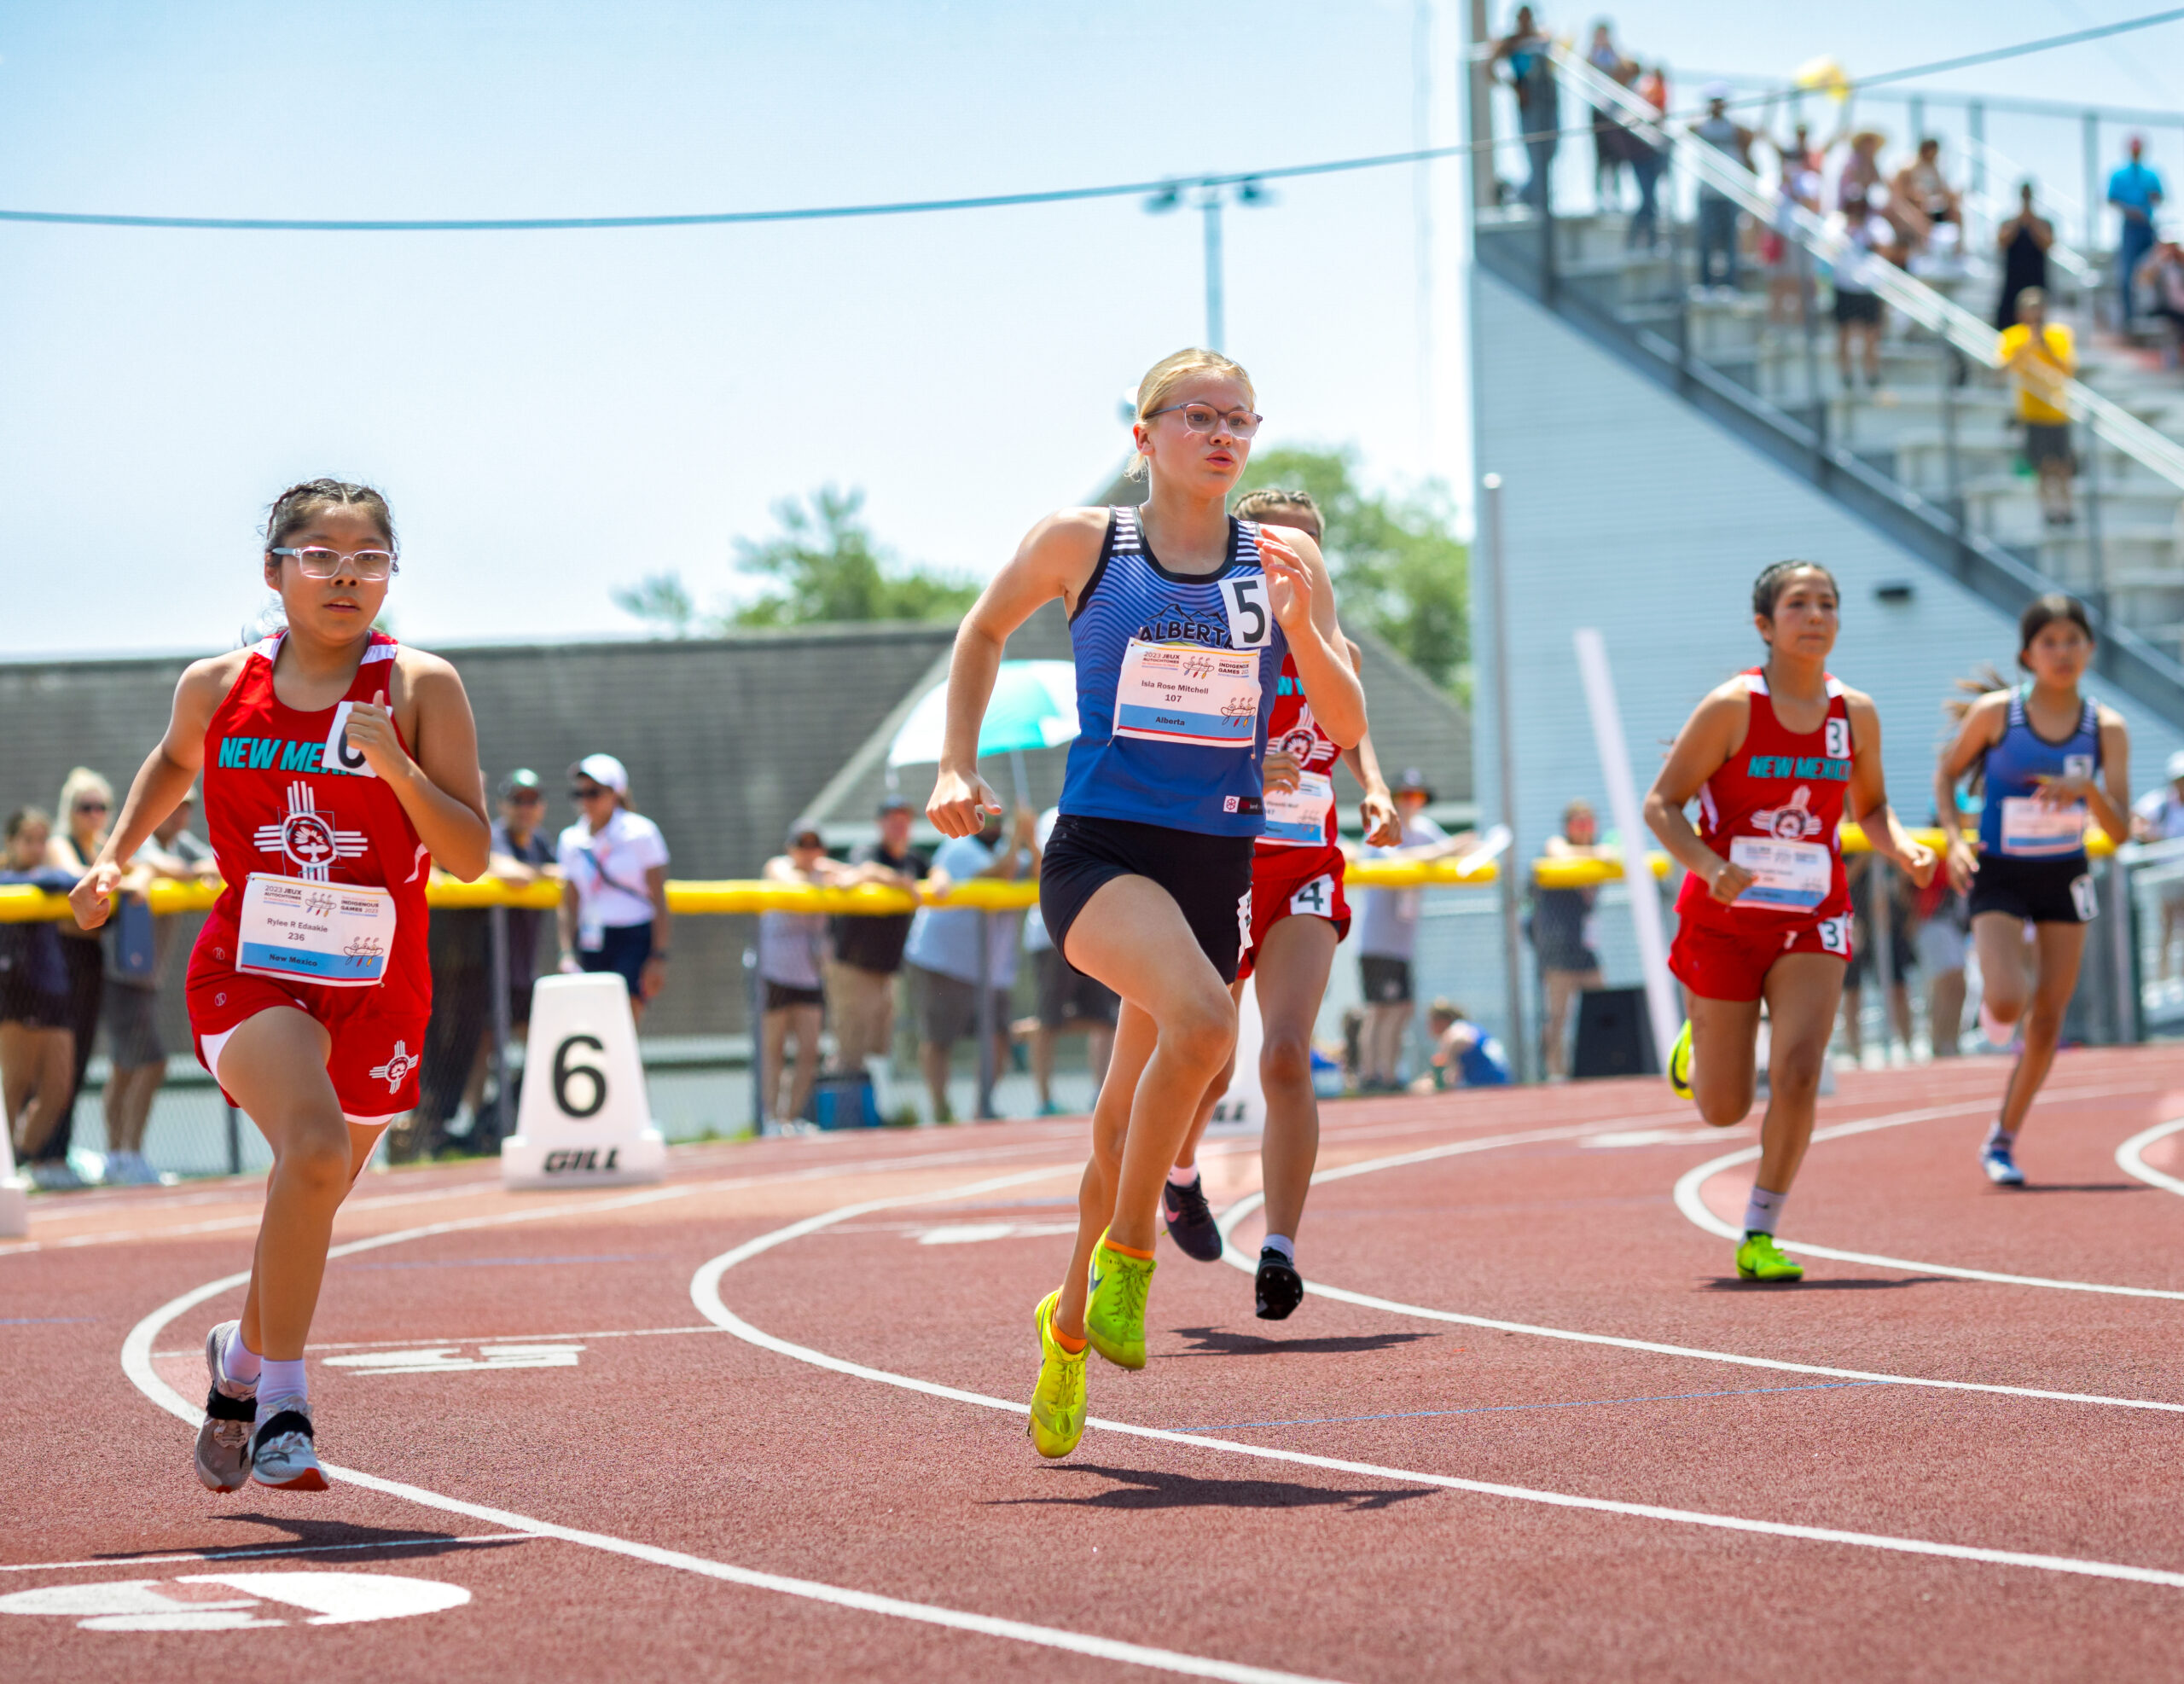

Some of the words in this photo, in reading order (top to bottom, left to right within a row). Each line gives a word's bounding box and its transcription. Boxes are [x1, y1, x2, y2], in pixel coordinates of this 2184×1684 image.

[1232, 580, 1266, 644] 5
[1141, 680, 1155, 688] Isla
[1157, 682, 1176, 691] Rose
[1177, 685, 1209, 694] Mitchell
[1165, 694, 1182, 703] 107
[1155, 717, 1186, 726] Alberta
[1828, 721, 1842, 754] 3
[218, 736, 282, 769] NEW
[1747, 755, 1795, 778] NEW
[1298, 881, 1324, 911] 4
[266, 917, 288, 928] Rylee
[1823, 920, 1839, 948] 3
[288, 932, 305, 942] 236
[269, 953, 288, 963] New
[288, 955, 318, 967] Mexico
[552, 1034, 607, 1118] 6
[543, 1147, 619, 1175] GILL
